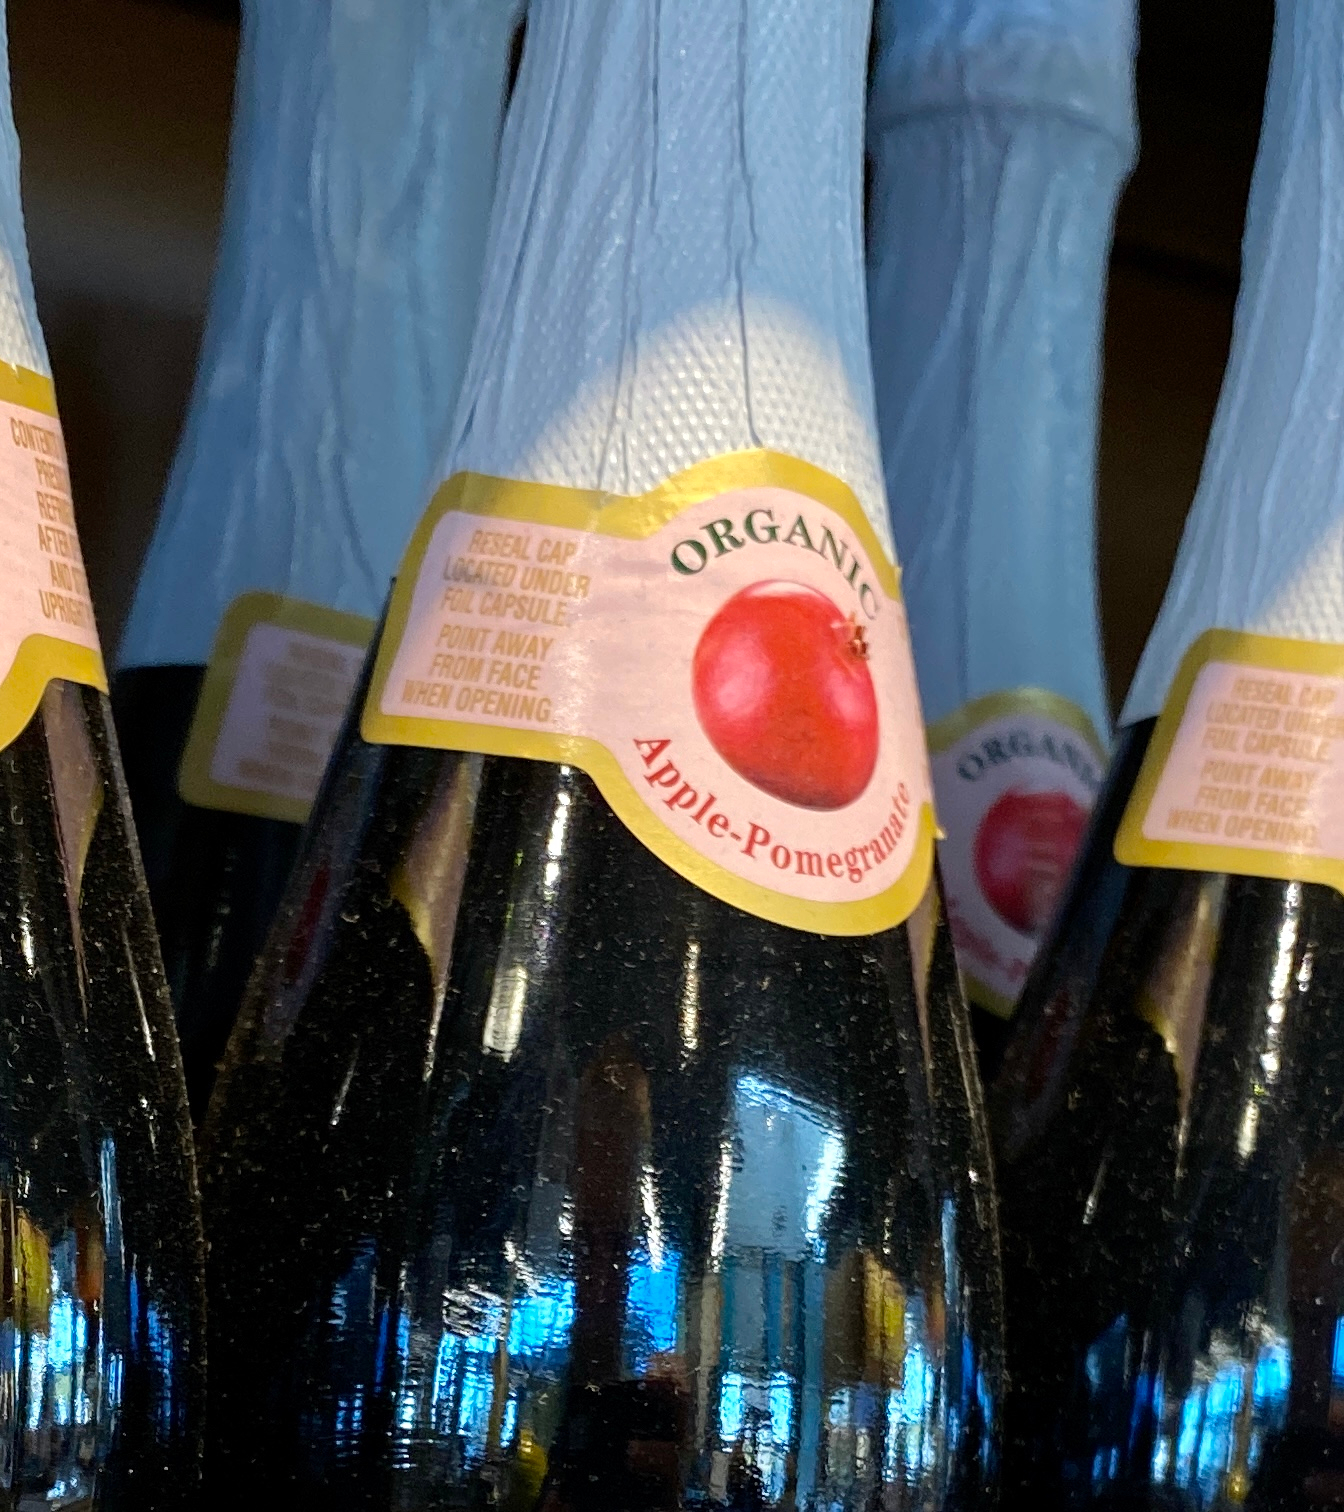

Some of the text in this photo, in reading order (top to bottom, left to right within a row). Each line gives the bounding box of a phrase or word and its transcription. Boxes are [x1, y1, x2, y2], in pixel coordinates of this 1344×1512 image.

[468, 530, 577, 566] RESEAL CAP
[669, 508, 880, 621] ORGANIC
[442, 556, 591, 599] LOCATED UNDER
[440, 587, 473, 614] FOIL
[435, 624, 554, 661] POINT AWAY
[428, 653, 542, 690] FROM FACE
[402, 680, 453, 710] WHEN
[632, 734, 911, 884] Apple-Pomegranate
